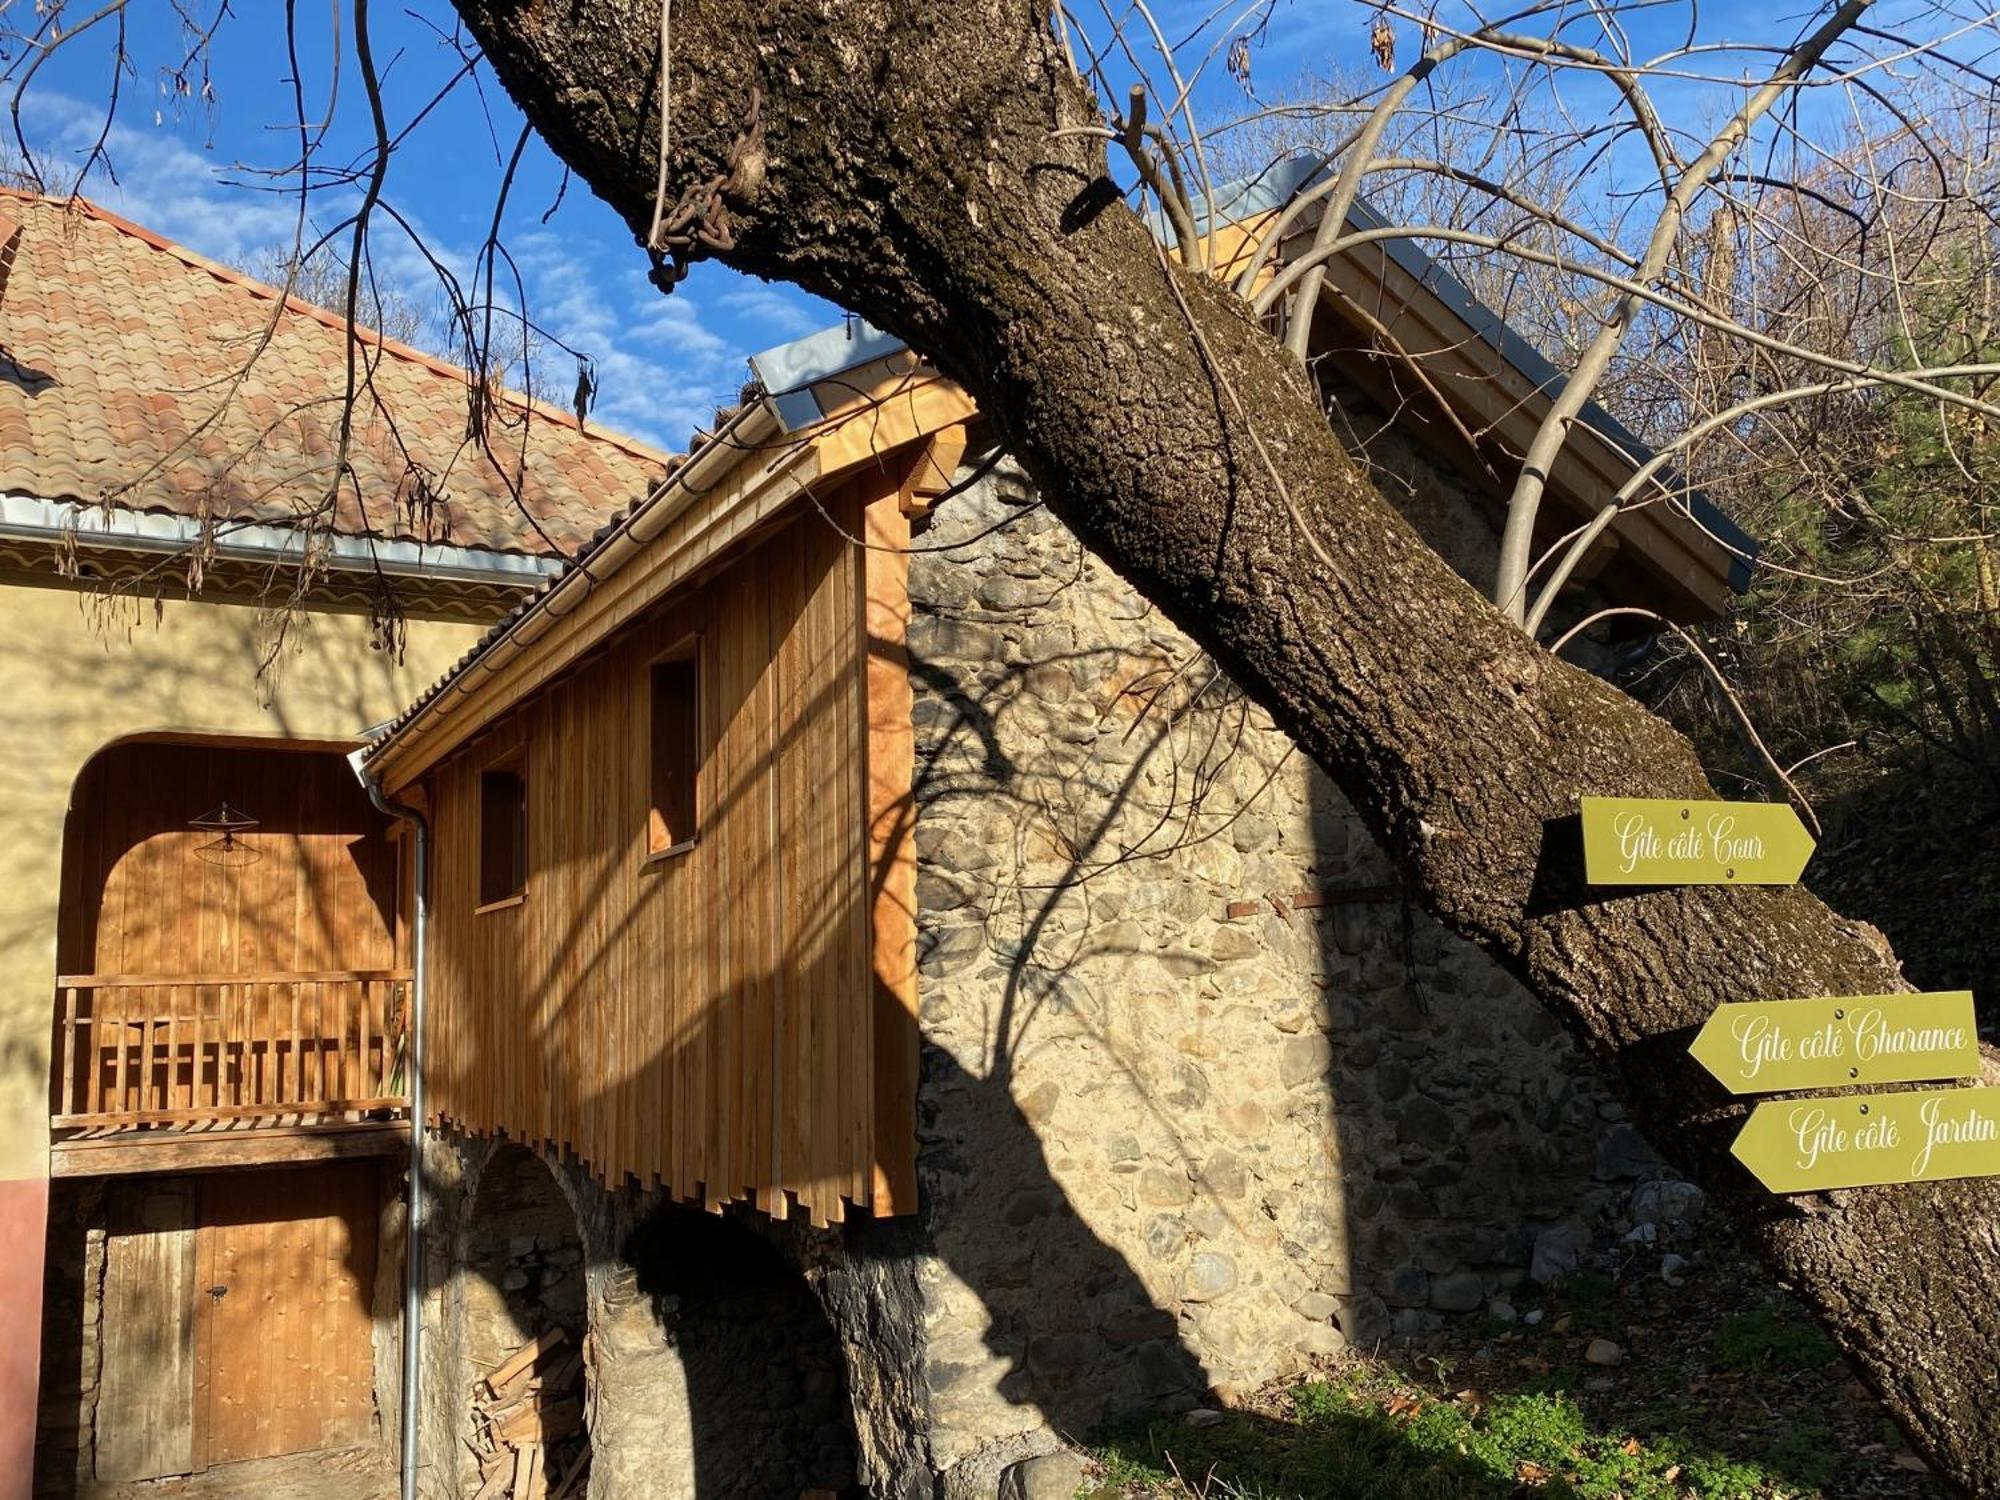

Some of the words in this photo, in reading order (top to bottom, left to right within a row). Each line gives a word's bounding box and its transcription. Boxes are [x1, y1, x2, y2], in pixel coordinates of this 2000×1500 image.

[1614, 811, 1662, 874] Gîte
[1668, 826, 1705, 860] côté
[1707, 813, 1765, 864] Cour
[1731, 1014, 1793, 1079] Gîte
[1799, 1023, 1846, 1058] côté
[1848, 1007, 1968, 1061] Charance
[1789, 1107, 1849, 1170] Gîte
[1855, 1115, 1900, 1150] côté
[1912, 1097, 1999, 1177] Jardin
